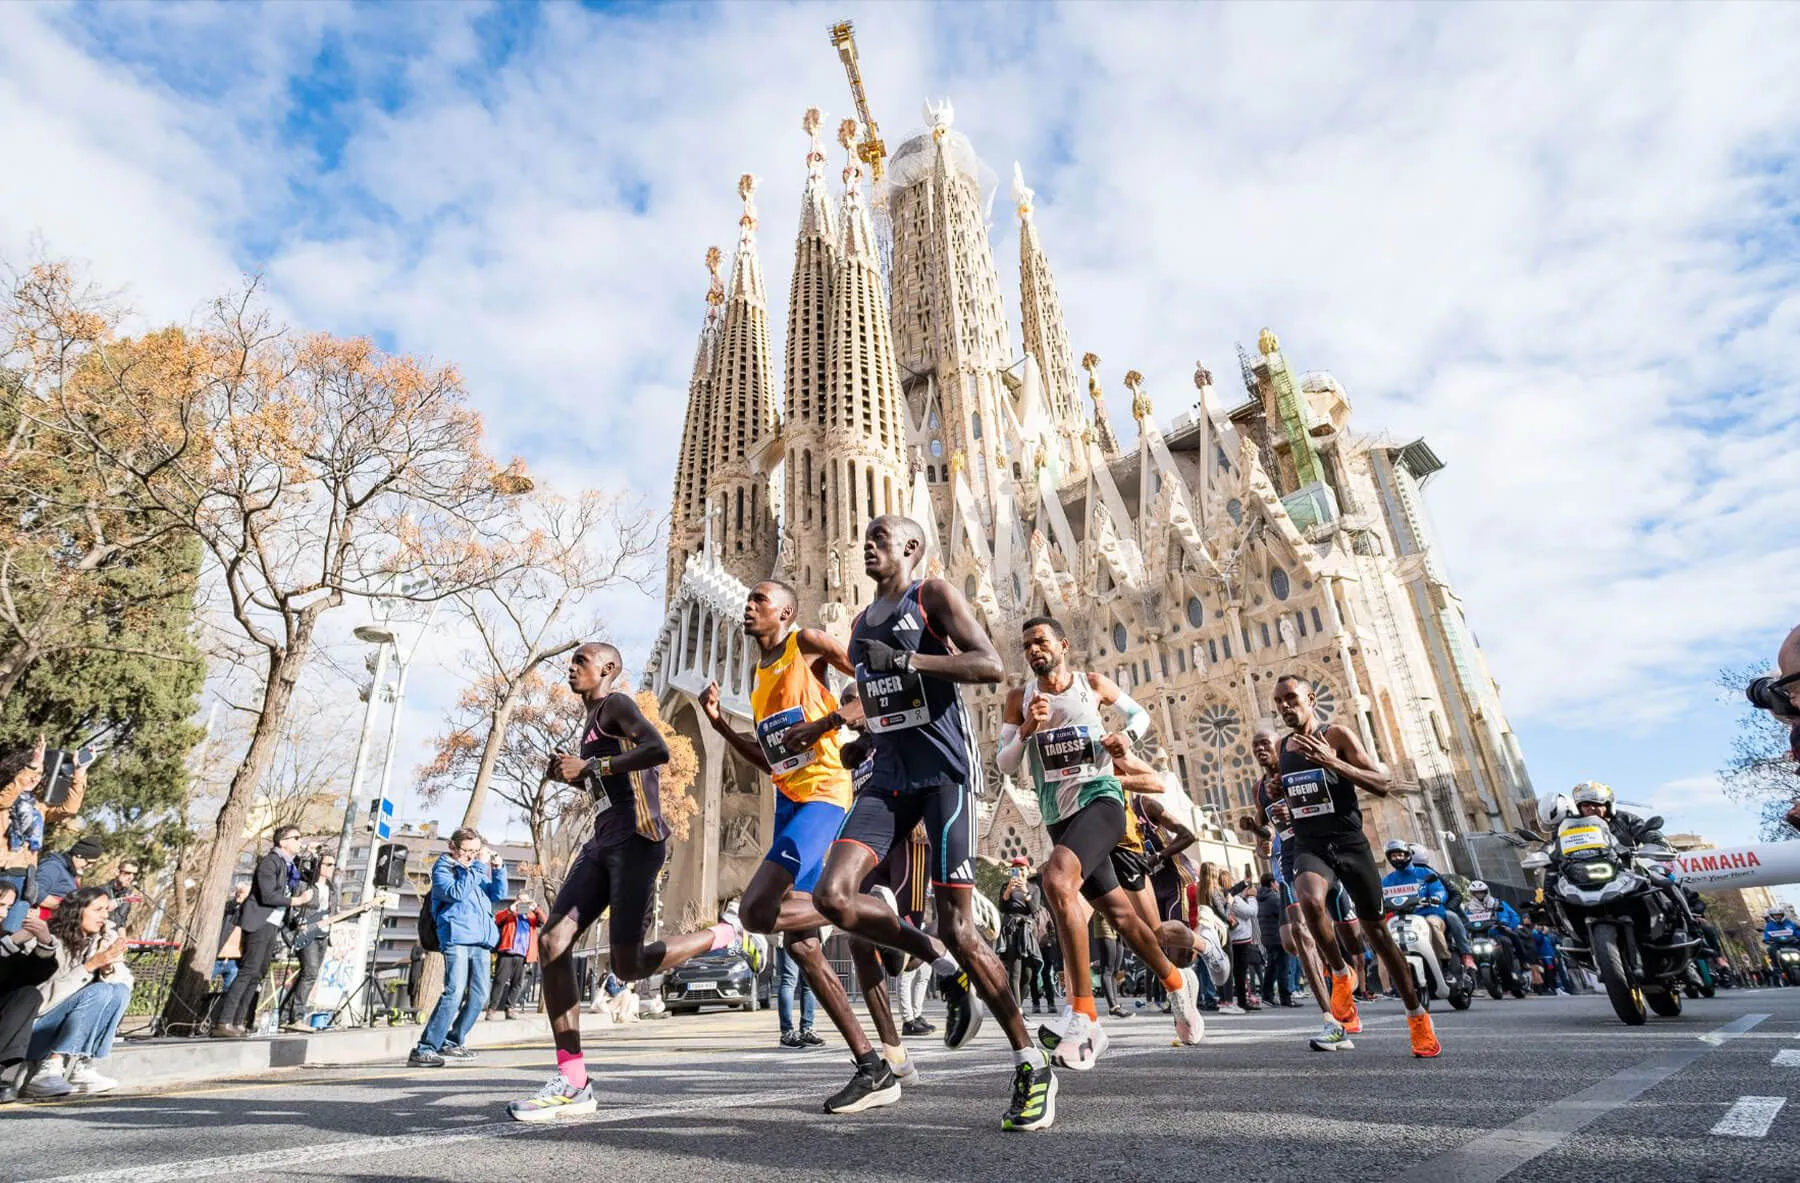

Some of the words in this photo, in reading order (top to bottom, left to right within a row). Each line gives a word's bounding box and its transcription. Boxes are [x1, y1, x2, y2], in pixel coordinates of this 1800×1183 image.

[866, 676, 903, 698] PACER
[879, 697, 889, 707] 27
[1044, 739, 1086, 756] TADESSE
[1678, 851, 1760, 872] YAMAHA
